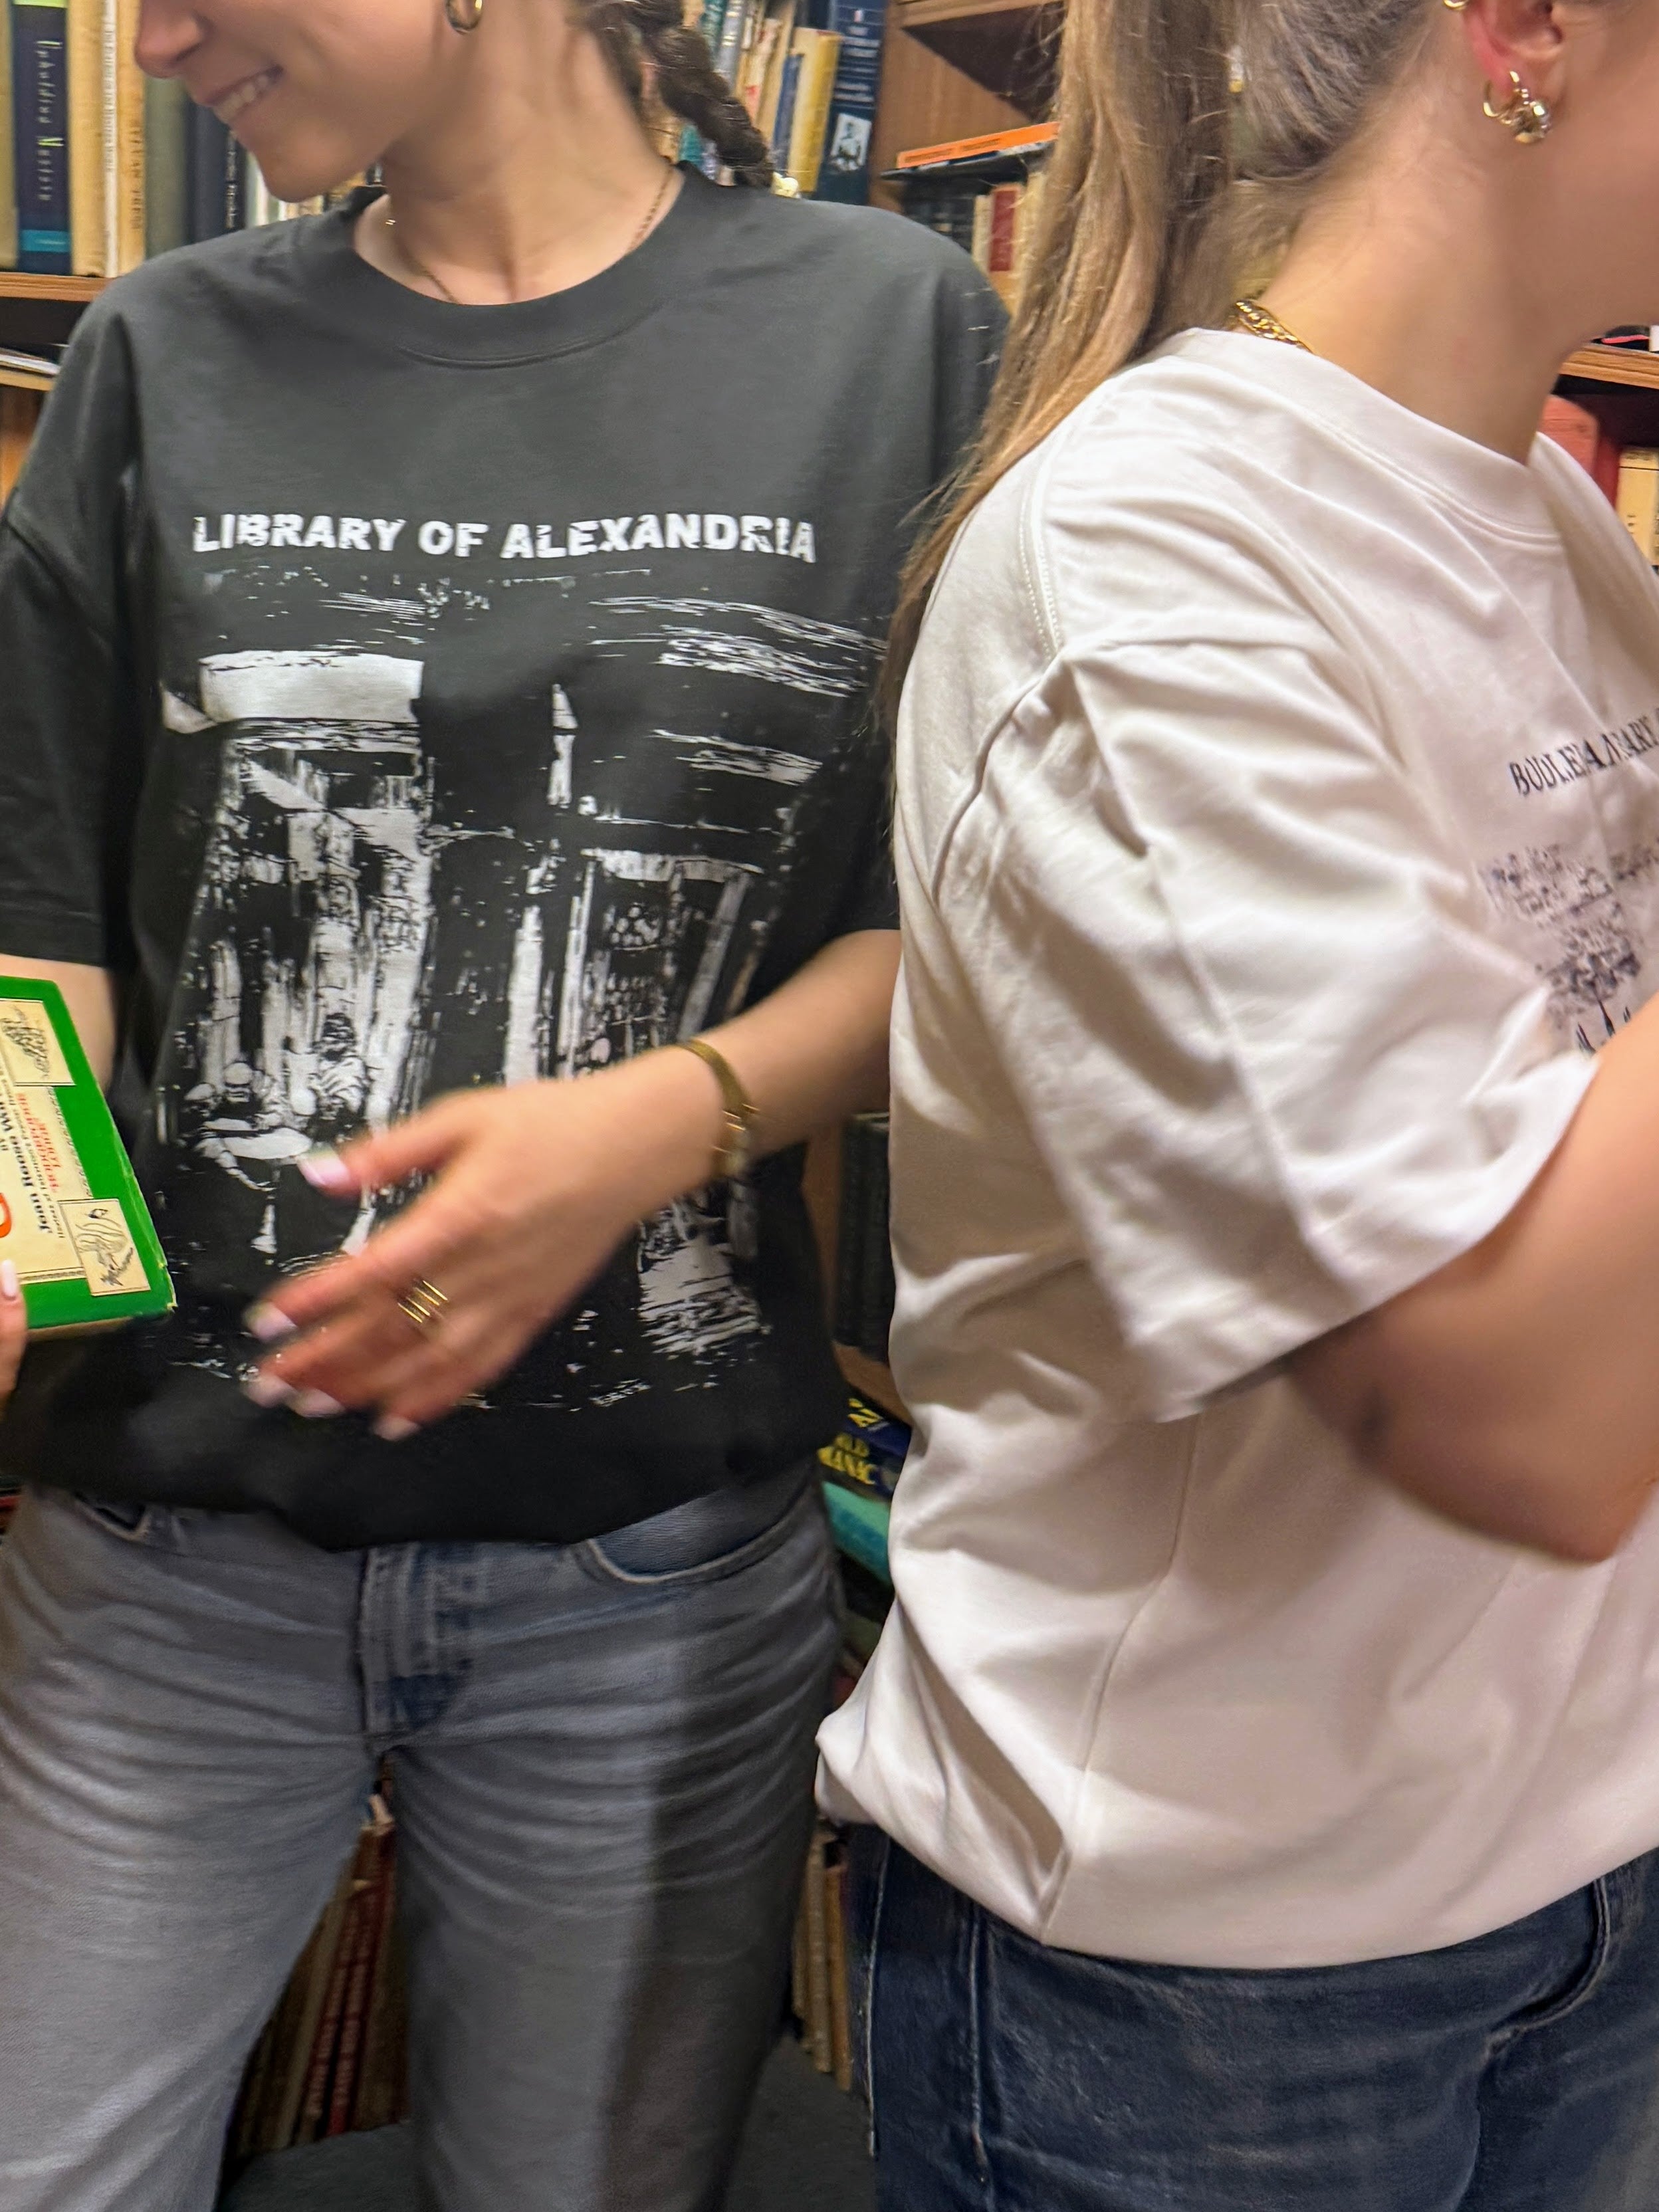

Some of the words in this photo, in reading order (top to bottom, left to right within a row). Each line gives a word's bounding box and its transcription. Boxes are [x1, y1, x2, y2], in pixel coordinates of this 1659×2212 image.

[36, 40, 63, 124] Upholding
[37, 136, 64, 200] Mystery
[193, 513, 407, 552] LIBRARY
[419, 520, 489, 557] OF
[500, 513, 816, 564] ALEXANDRIA
